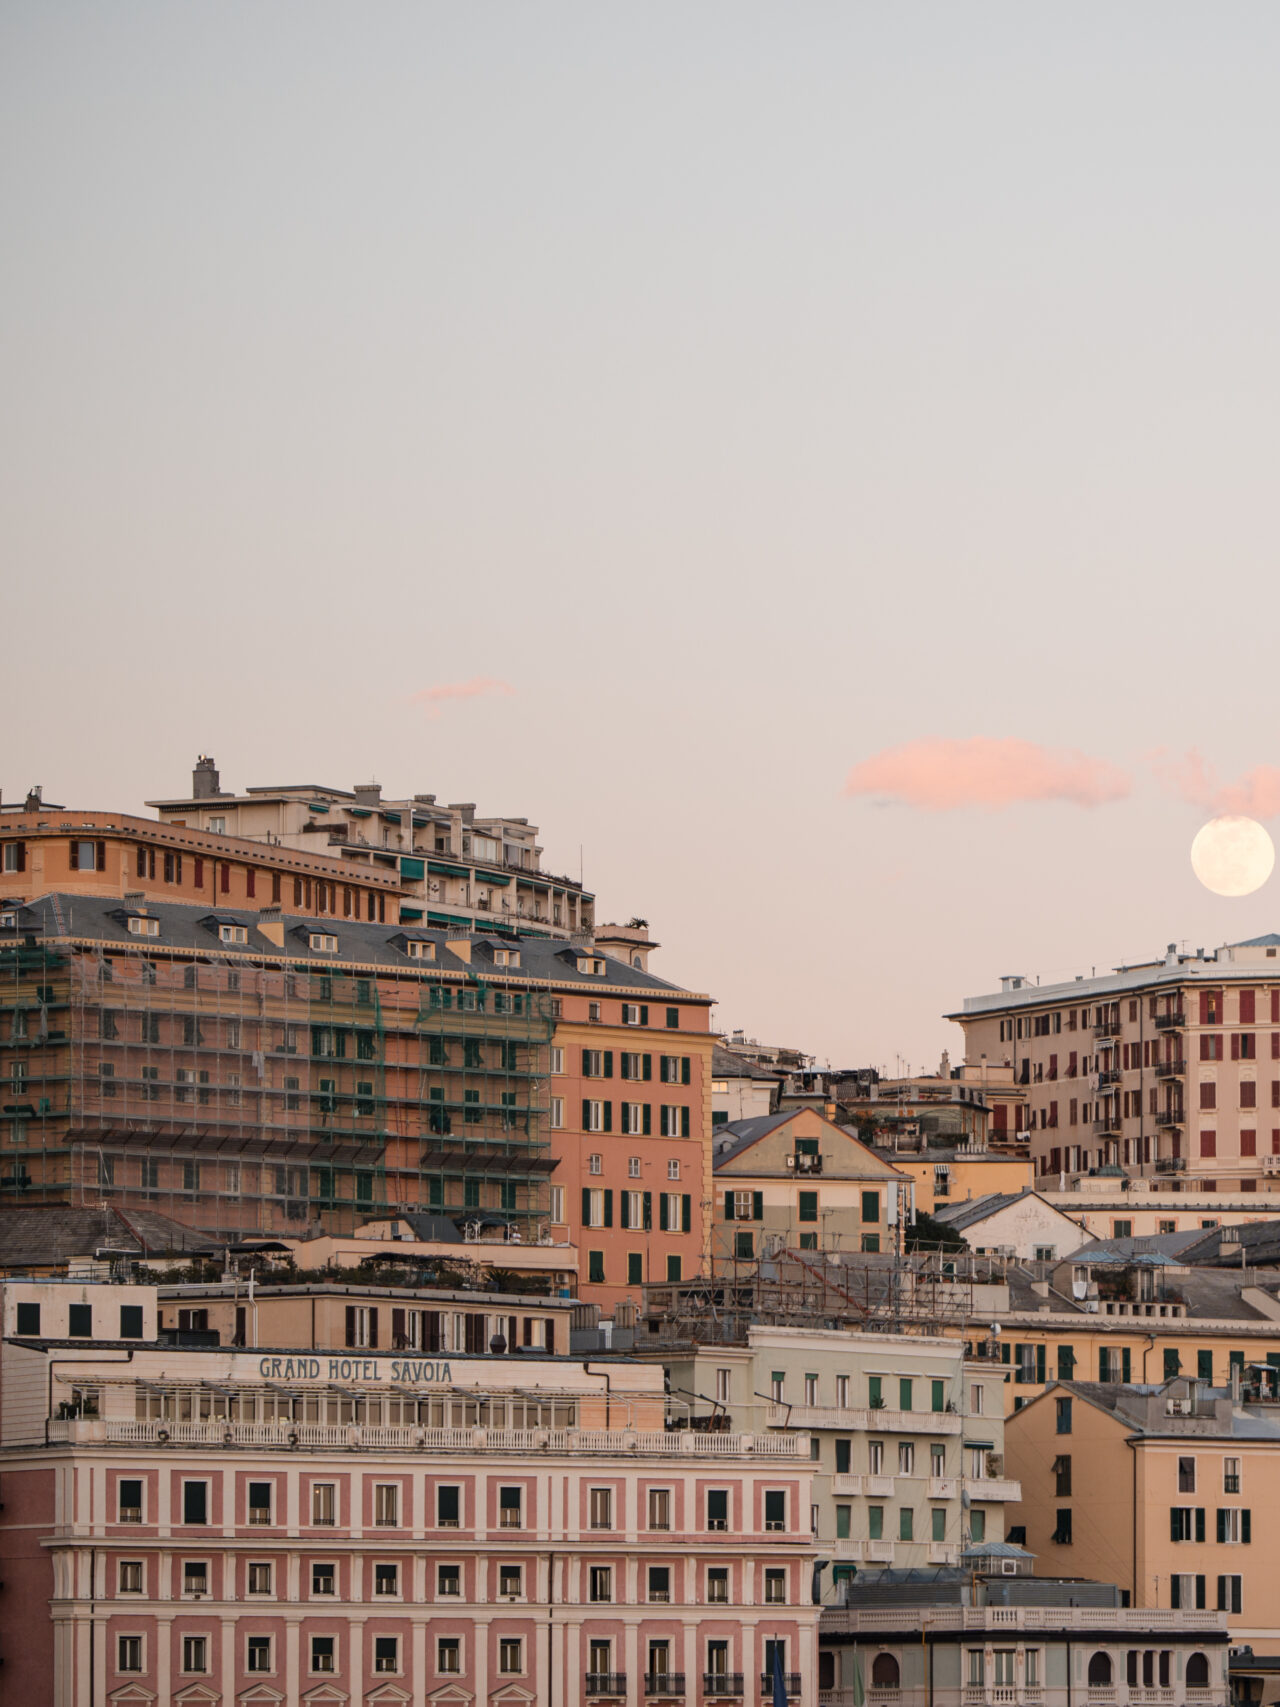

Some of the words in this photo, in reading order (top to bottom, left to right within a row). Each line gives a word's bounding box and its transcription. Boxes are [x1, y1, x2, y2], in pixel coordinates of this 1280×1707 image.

[260, 1357, 320, 1378] GRAND
[328, 1359, 382, 1381] HOTEL
[391, 1361, 452, 1382] SAVOIA
